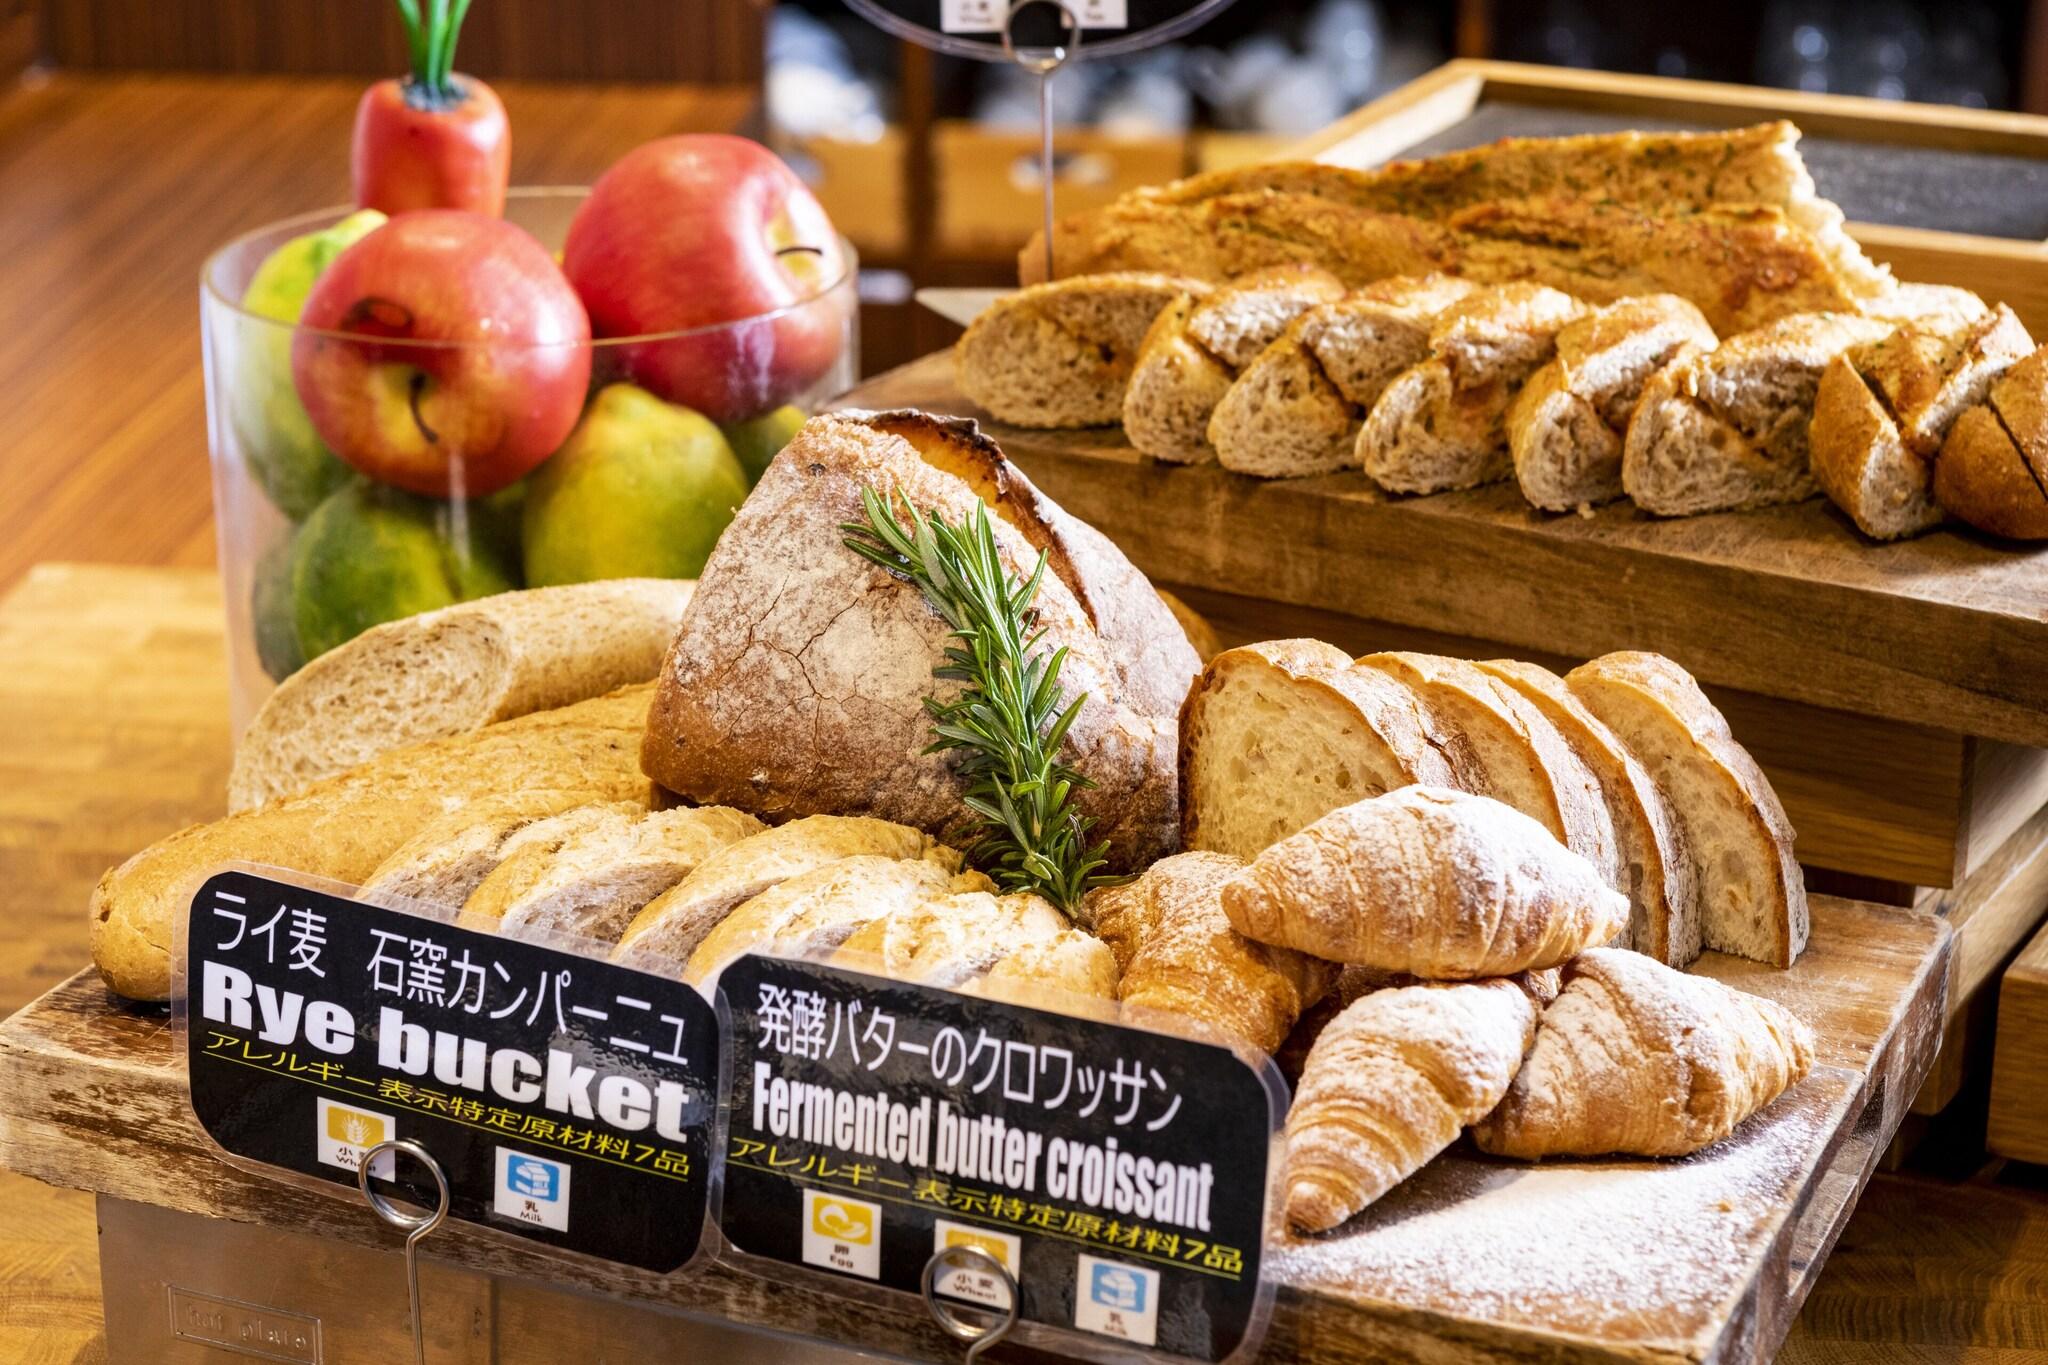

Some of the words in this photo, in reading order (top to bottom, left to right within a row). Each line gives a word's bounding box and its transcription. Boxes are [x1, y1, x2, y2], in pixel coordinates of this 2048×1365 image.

[202, 959, 356, 1056] Rye
[377, 1005, 691, 1144] bucket
[212, 890, 328, 979] ライ麦
[366, 927, 689, 1066] 石窯カンパーニュ
[756, 981, 1183, 1132] 発酵バターのクロワッサン
[520, 1211, 543, 1224] Milk
[752, 1060, 933, 1168] Fermented
[934, 1099, 1043, 1192] butter
[1045, 1135, 1214, 1233] croissant
